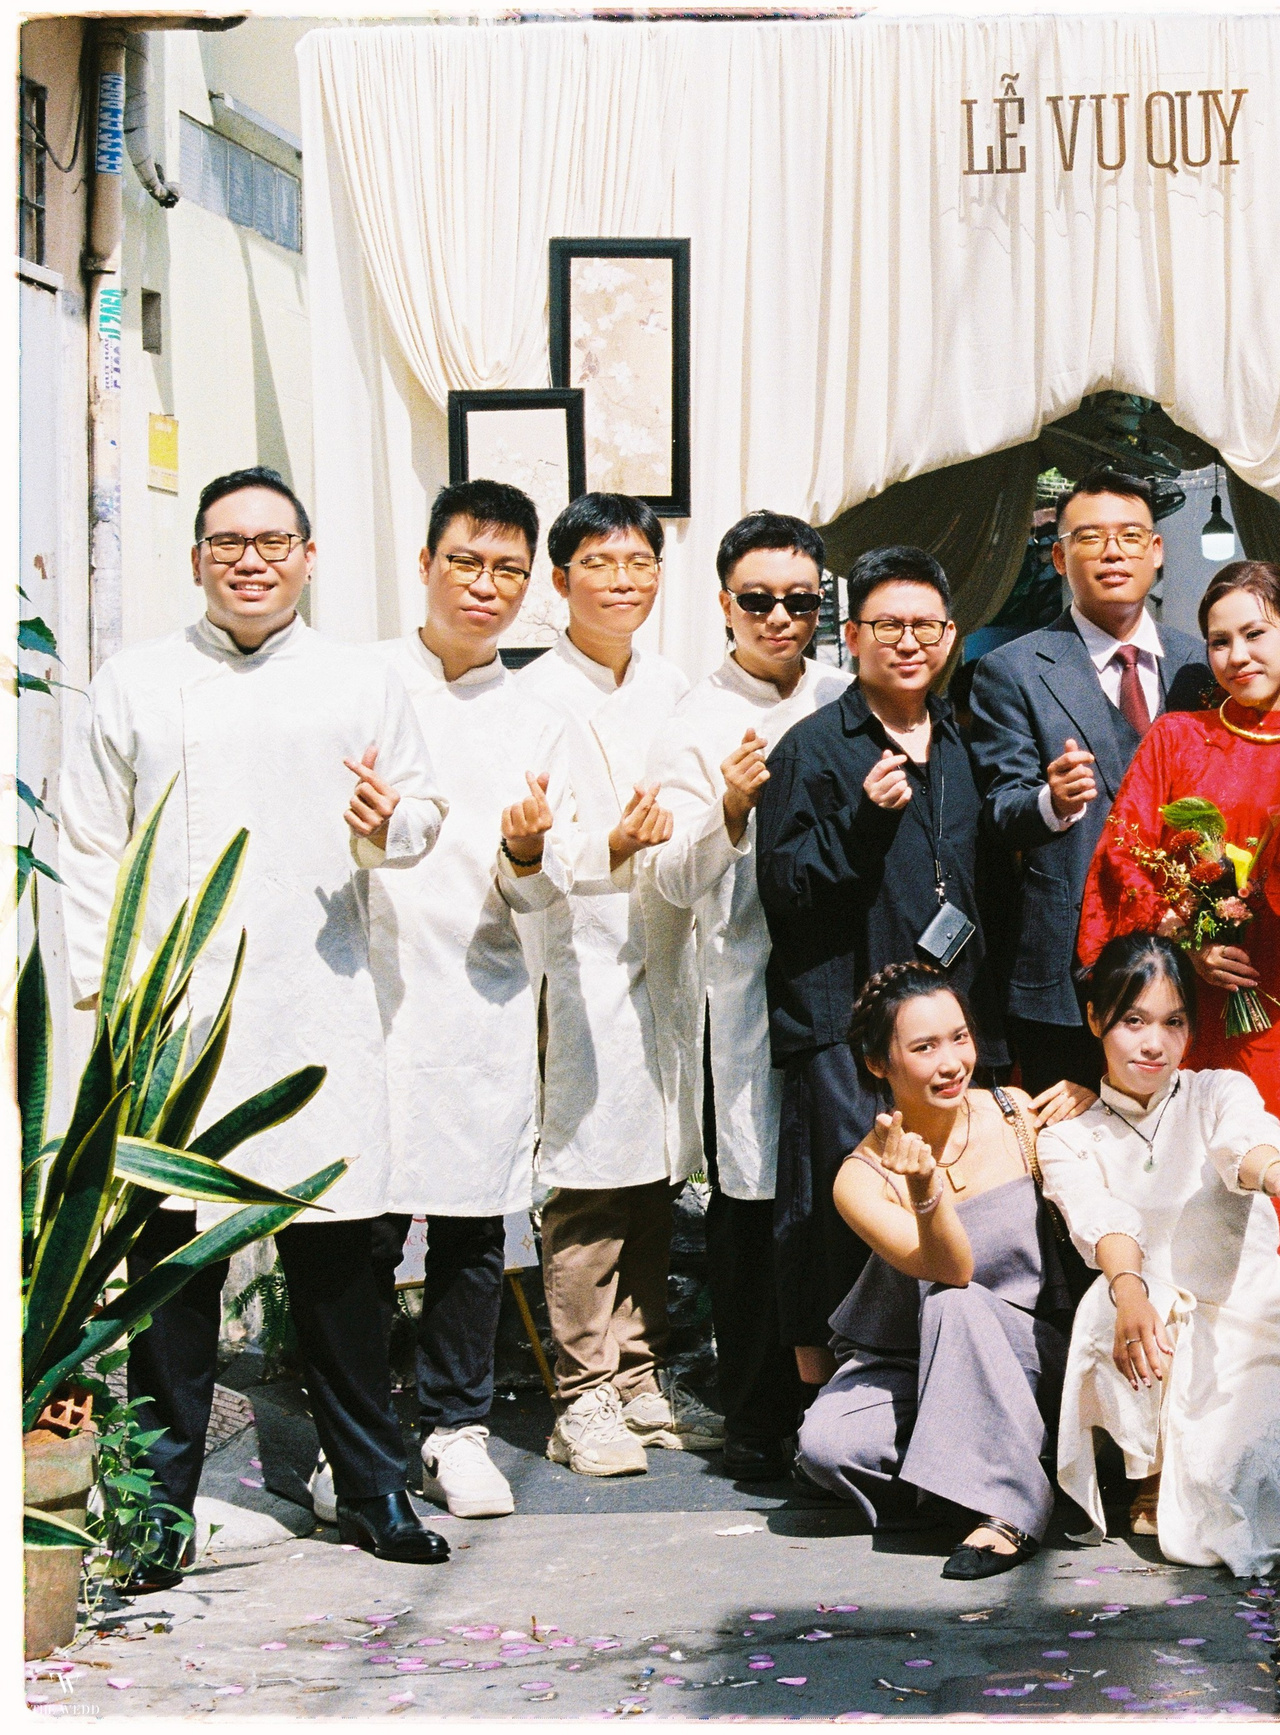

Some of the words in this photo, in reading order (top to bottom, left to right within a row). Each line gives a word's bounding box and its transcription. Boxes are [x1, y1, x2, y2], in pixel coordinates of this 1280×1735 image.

[960, 72, 1027, 176] LỄ
[1046, 93, 1130, 172] VU
[1144, 88, 1249, 174] QUY
